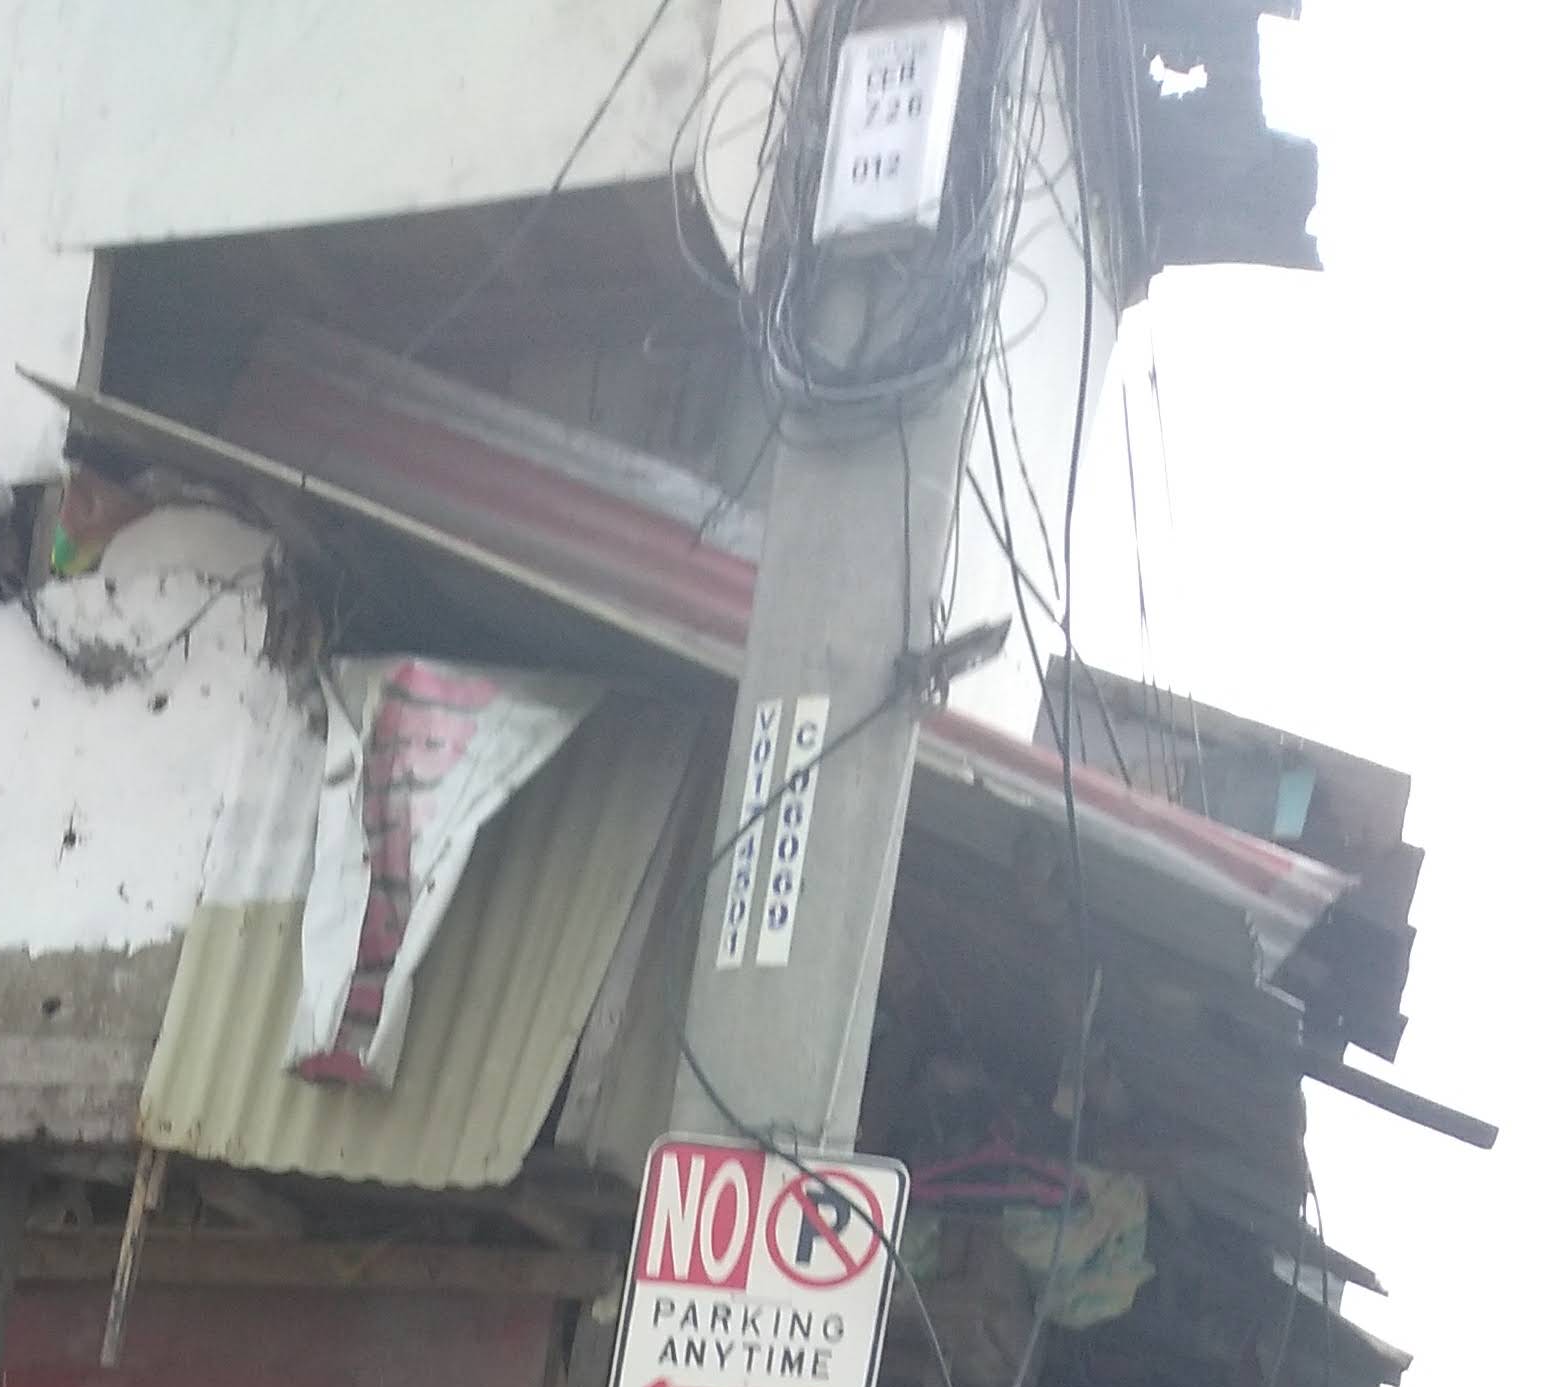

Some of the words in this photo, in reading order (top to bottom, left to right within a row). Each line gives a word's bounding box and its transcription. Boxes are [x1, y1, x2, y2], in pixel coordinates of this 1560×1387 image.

[646, 1152, 749, 1284] NO
[653, 1297, 845, 1348] PARKING
[659, 1336, 835, 1380] ANYTIME
